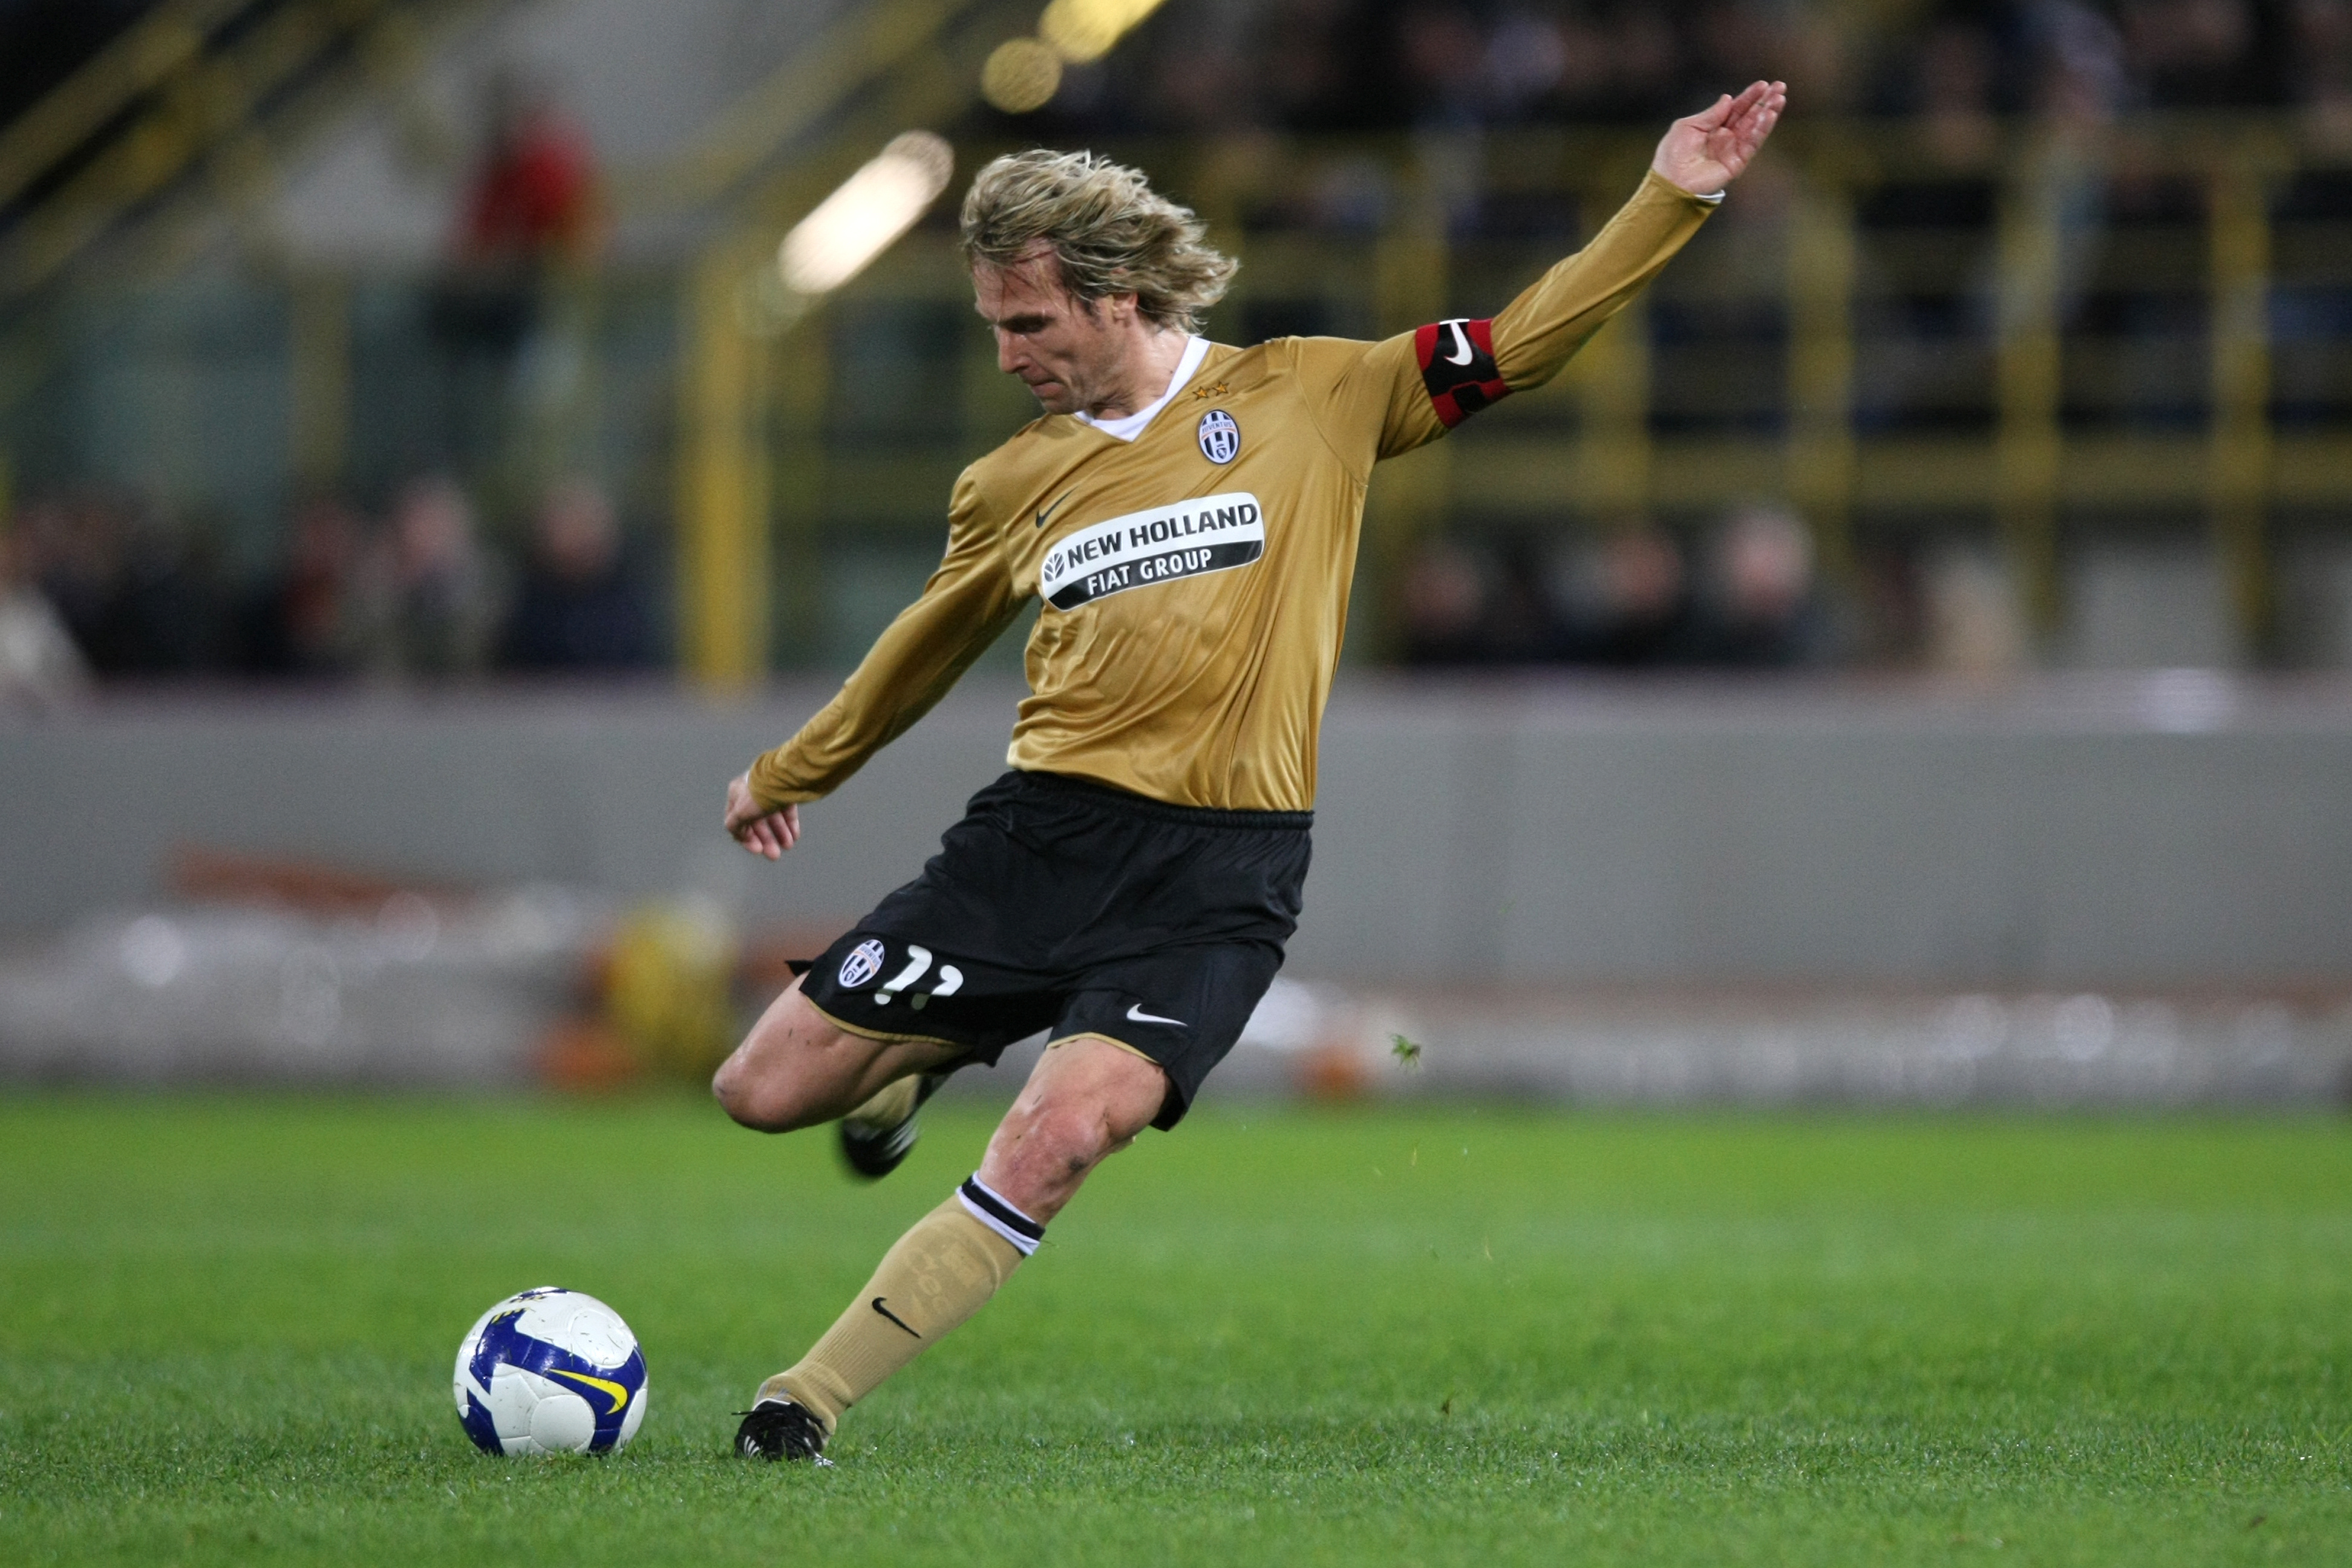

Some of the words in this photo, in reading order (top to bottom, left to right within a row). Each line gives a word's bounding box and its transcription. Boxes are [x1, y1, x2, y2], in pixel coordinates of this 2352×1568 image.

[1201, 421, 1232, 434] JUVENTUS
[1068, 531, 1122, 569] NEW
[1129, 503, 1258, 547] HOLLAND
[1088, 566, 1130, 595] FIAT
[1140, 549, 1212, 580] GROUP
